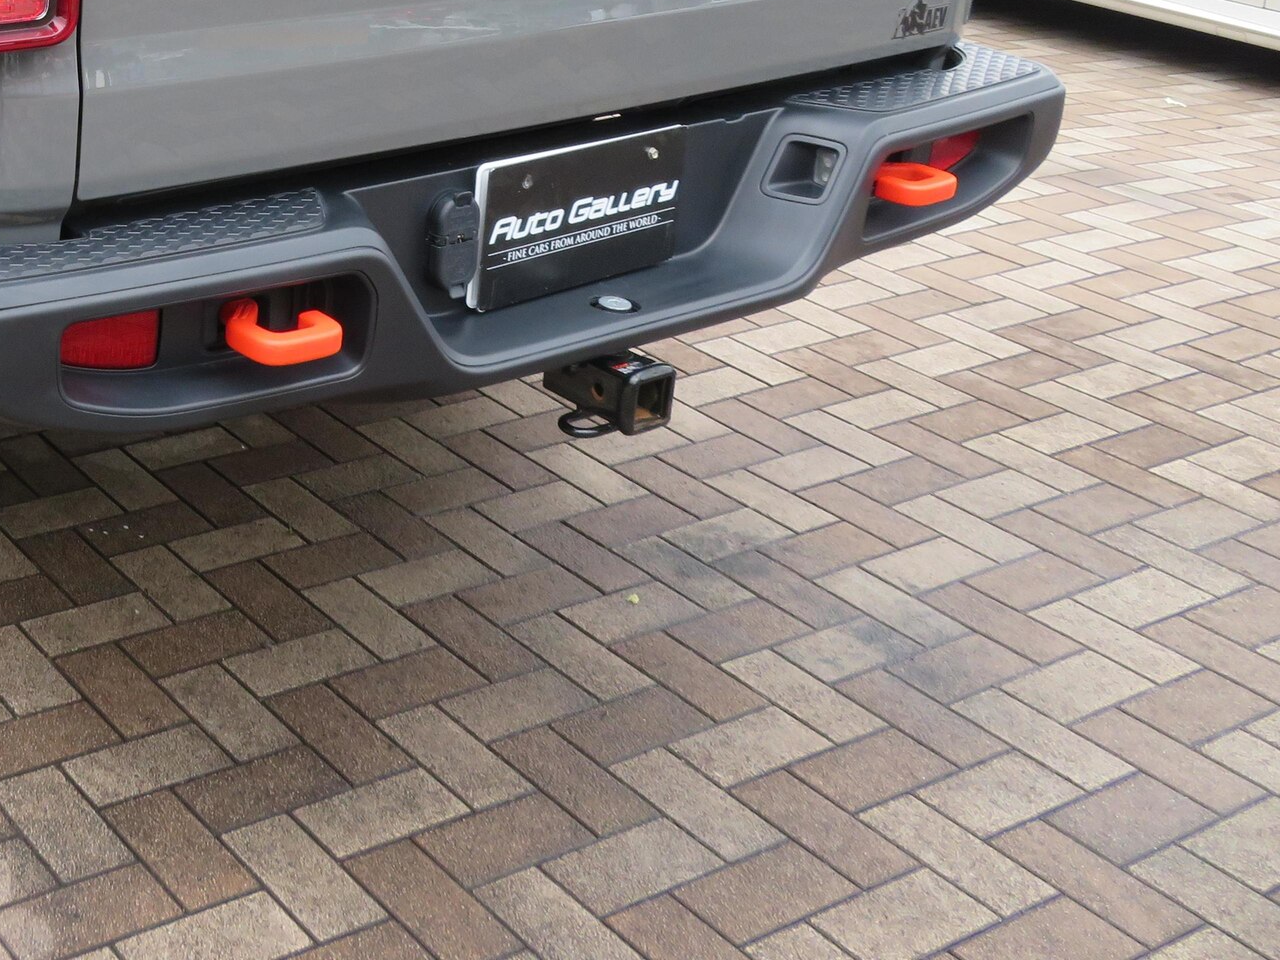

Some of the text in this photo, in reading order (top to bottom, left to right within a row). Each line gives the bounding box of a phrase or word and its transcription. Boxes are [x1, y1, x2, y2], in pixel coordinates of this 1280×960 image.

[926, 6, 948, 30] AEV
[528, 241, 550, 256] CARS
[550, 234, 575, 251] FROM
[575, 227, 611, 244] AROUND
[611, 222, 629, 235] THE
